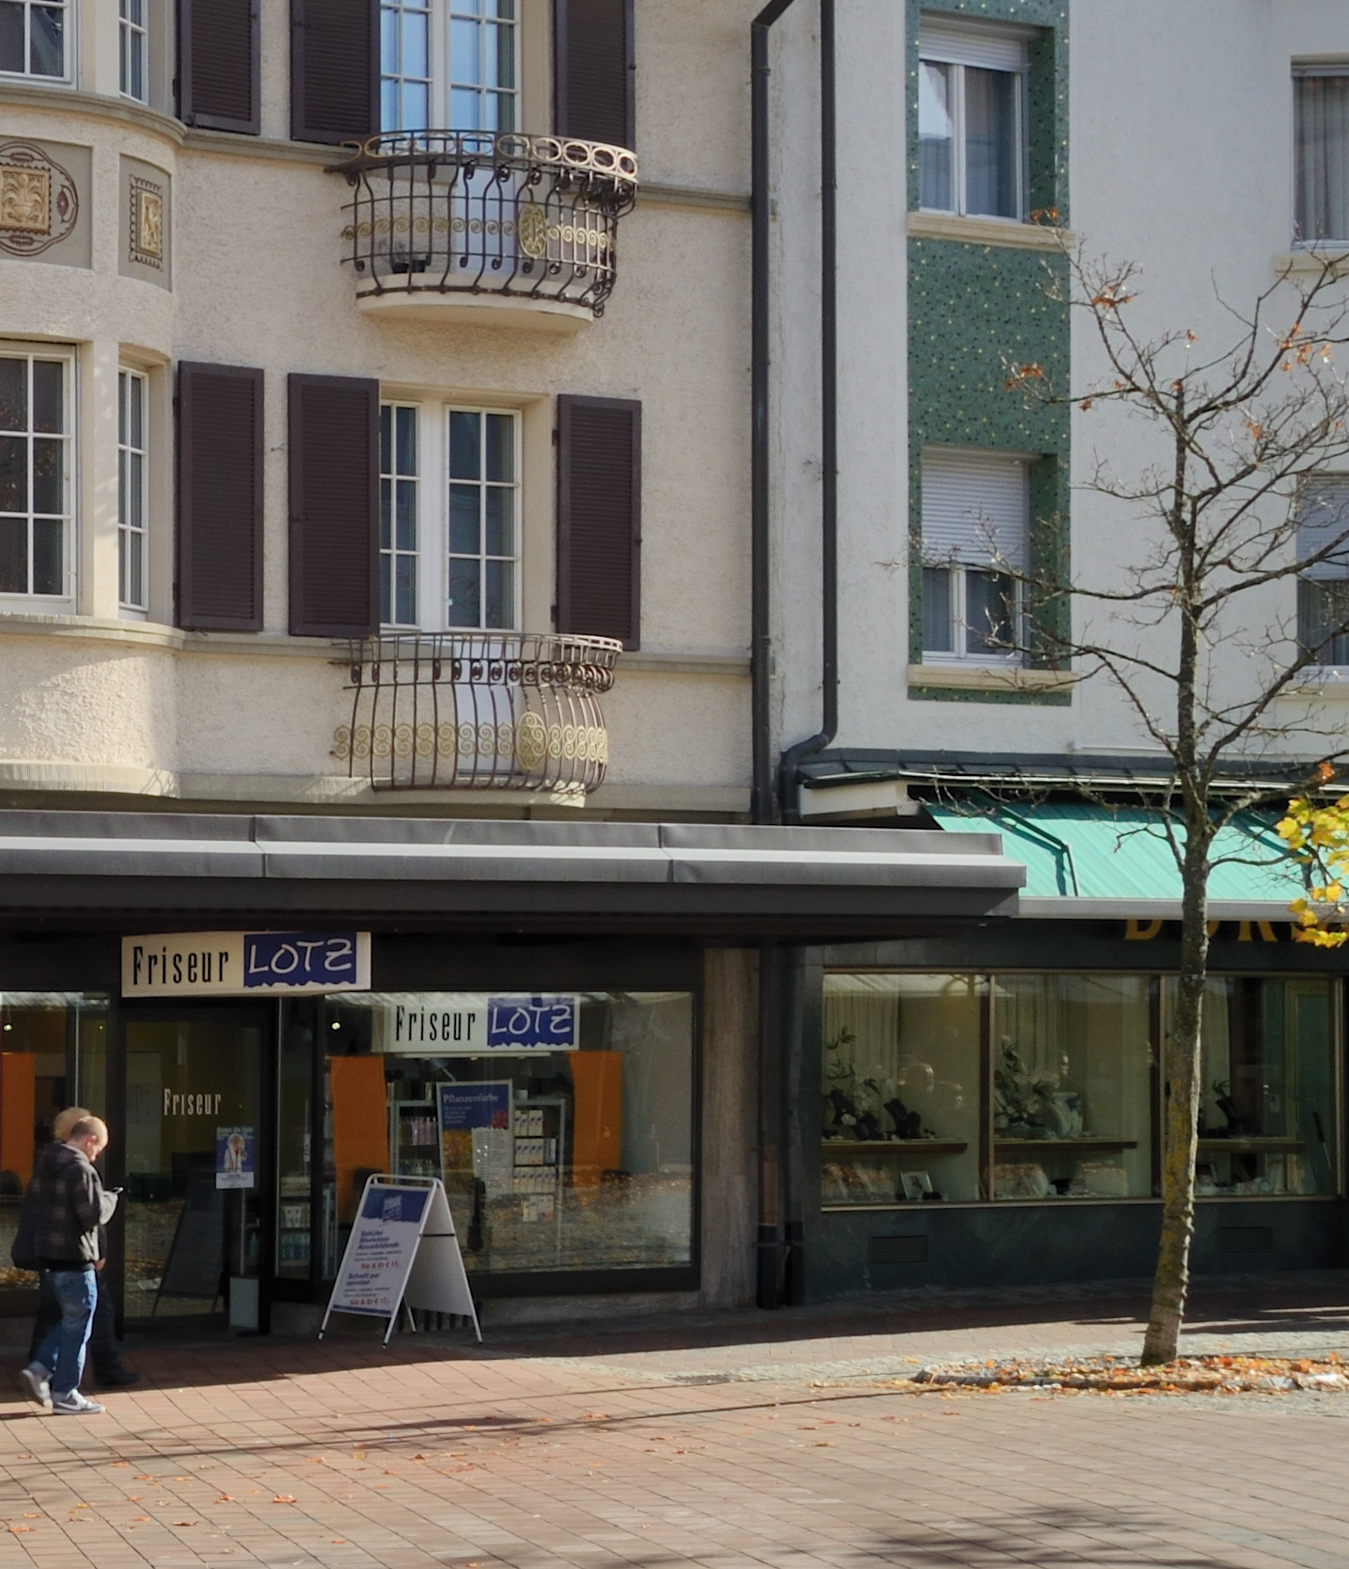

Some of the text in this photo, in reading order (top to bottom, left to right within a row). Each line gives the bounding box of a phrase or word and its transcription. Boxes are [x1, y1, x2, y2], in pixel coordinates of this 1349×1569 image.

[132, 945, 229, 985] Friseur
[247, 937, 353, 974] LOTZ
[395, 1005, 476, 1042] Friseur
[491, 1003, 572, 1036] LOTZ
[163, 1088, 222, 1117] Friseur
[443, 1092, 499, 1104] Pflanzenfarbe
